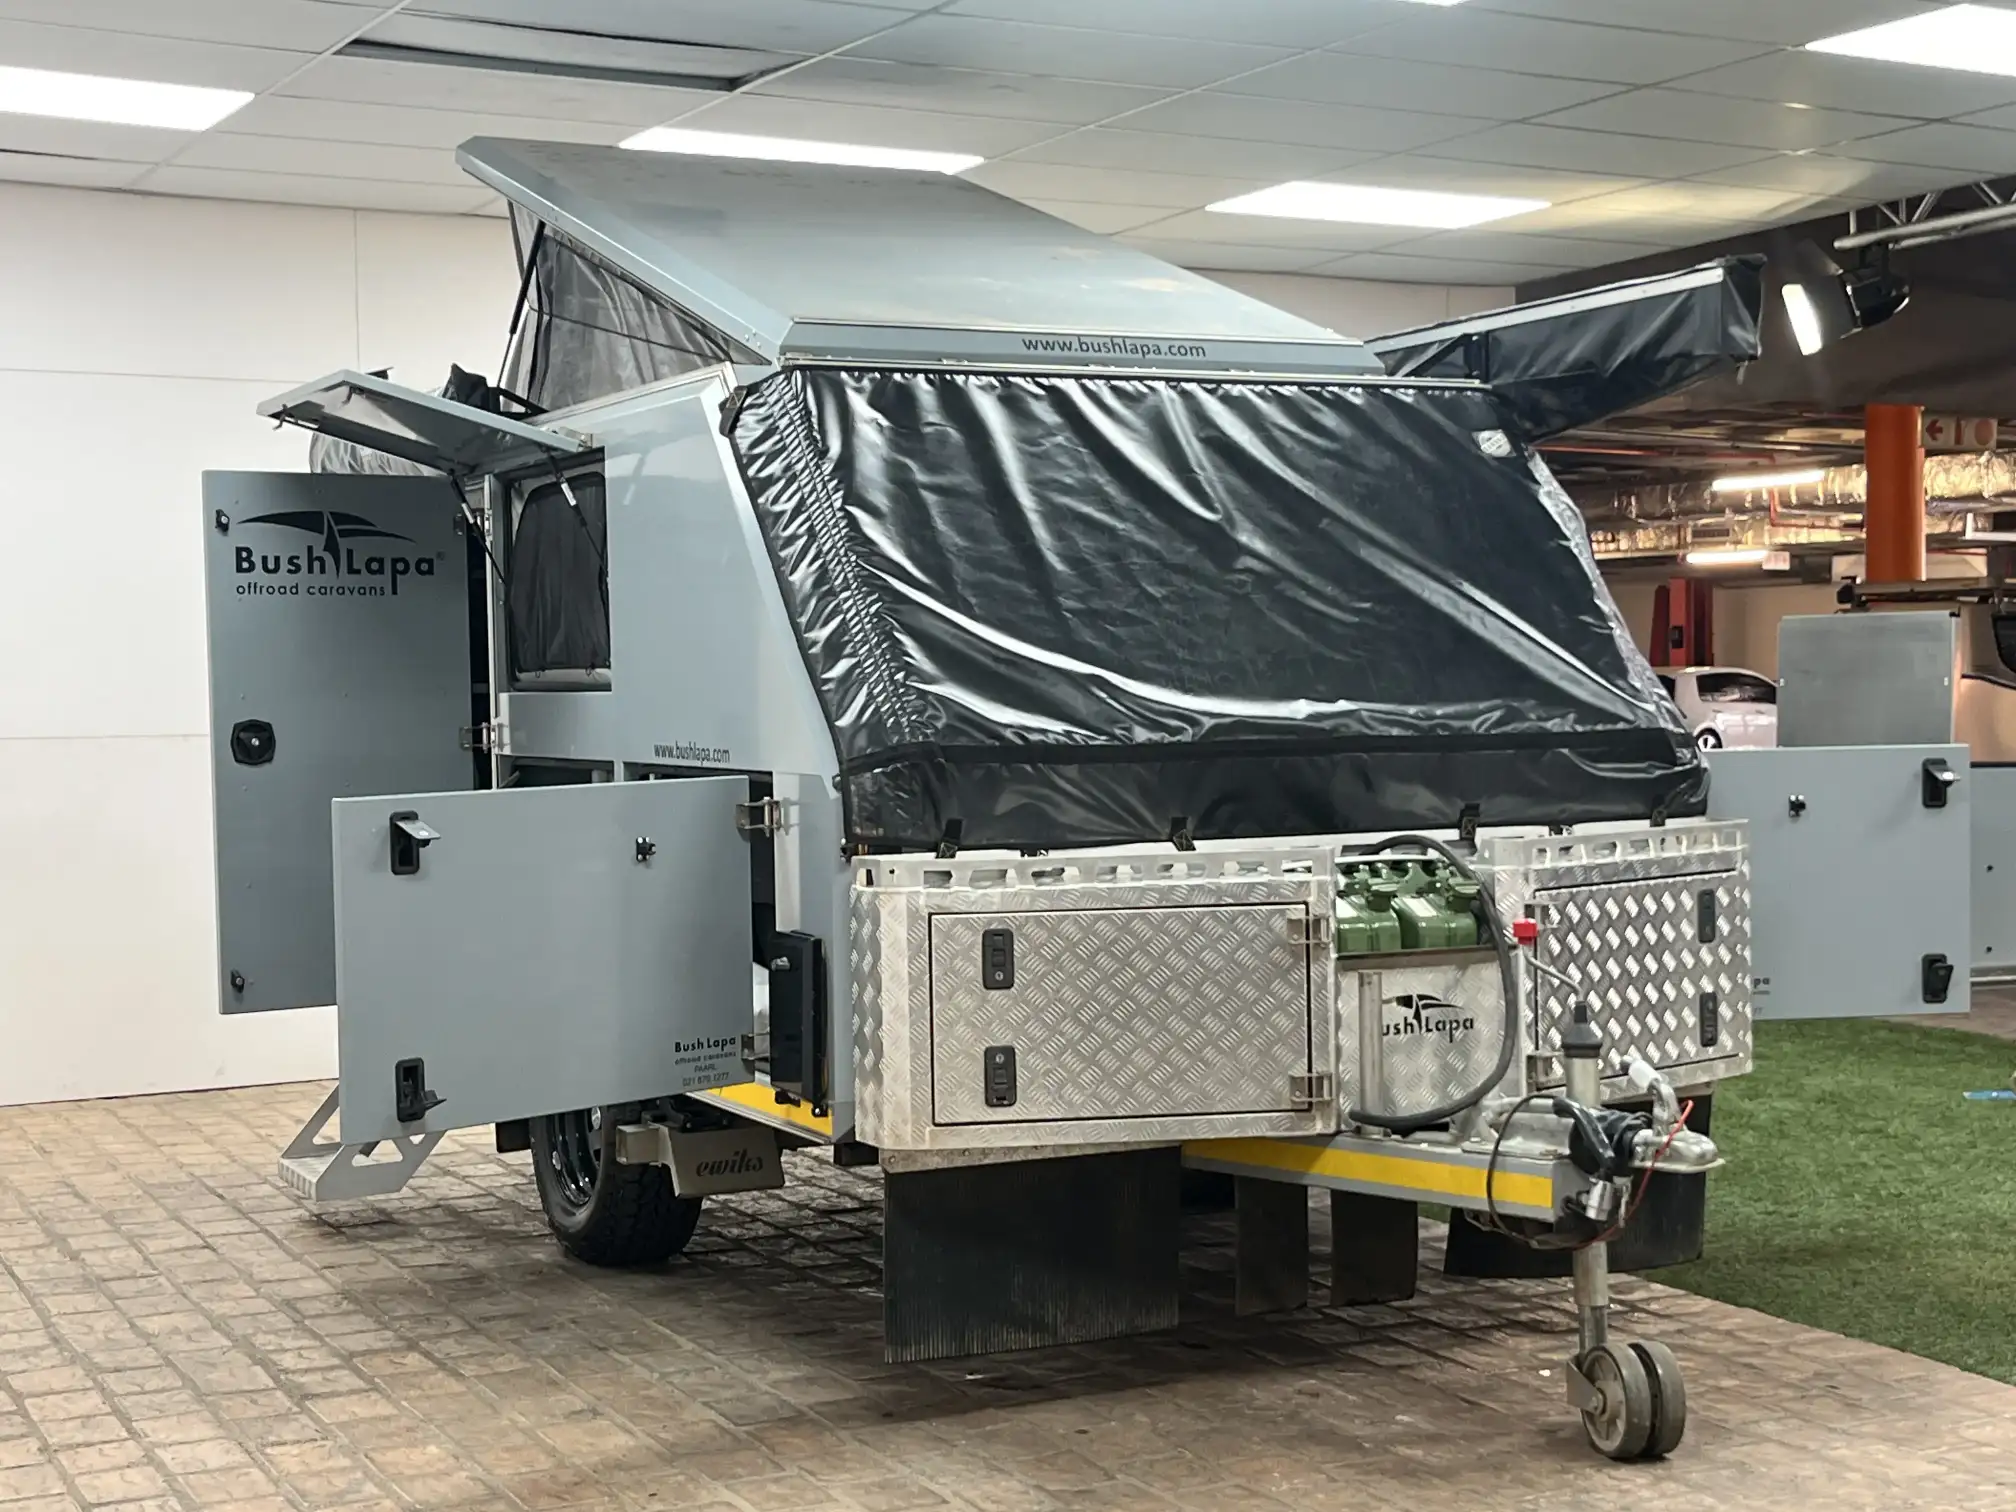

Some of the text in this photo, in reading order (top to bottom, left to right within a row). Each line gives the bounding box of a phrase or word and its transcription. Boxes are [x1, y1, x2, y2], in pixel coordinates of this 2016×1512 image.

[1021, 336, 1207, 358] www.bushlapa.com
[235, 546, 434, 596] Bush Lapa
[236, 582, 386, 597] offroad caravans
[653, 739, 731, 767] www.bushlapa.com
[1382, 1015, 1474, 1043] ush Lapa
[674, 1036, 737, 1053] Bush Lapa
